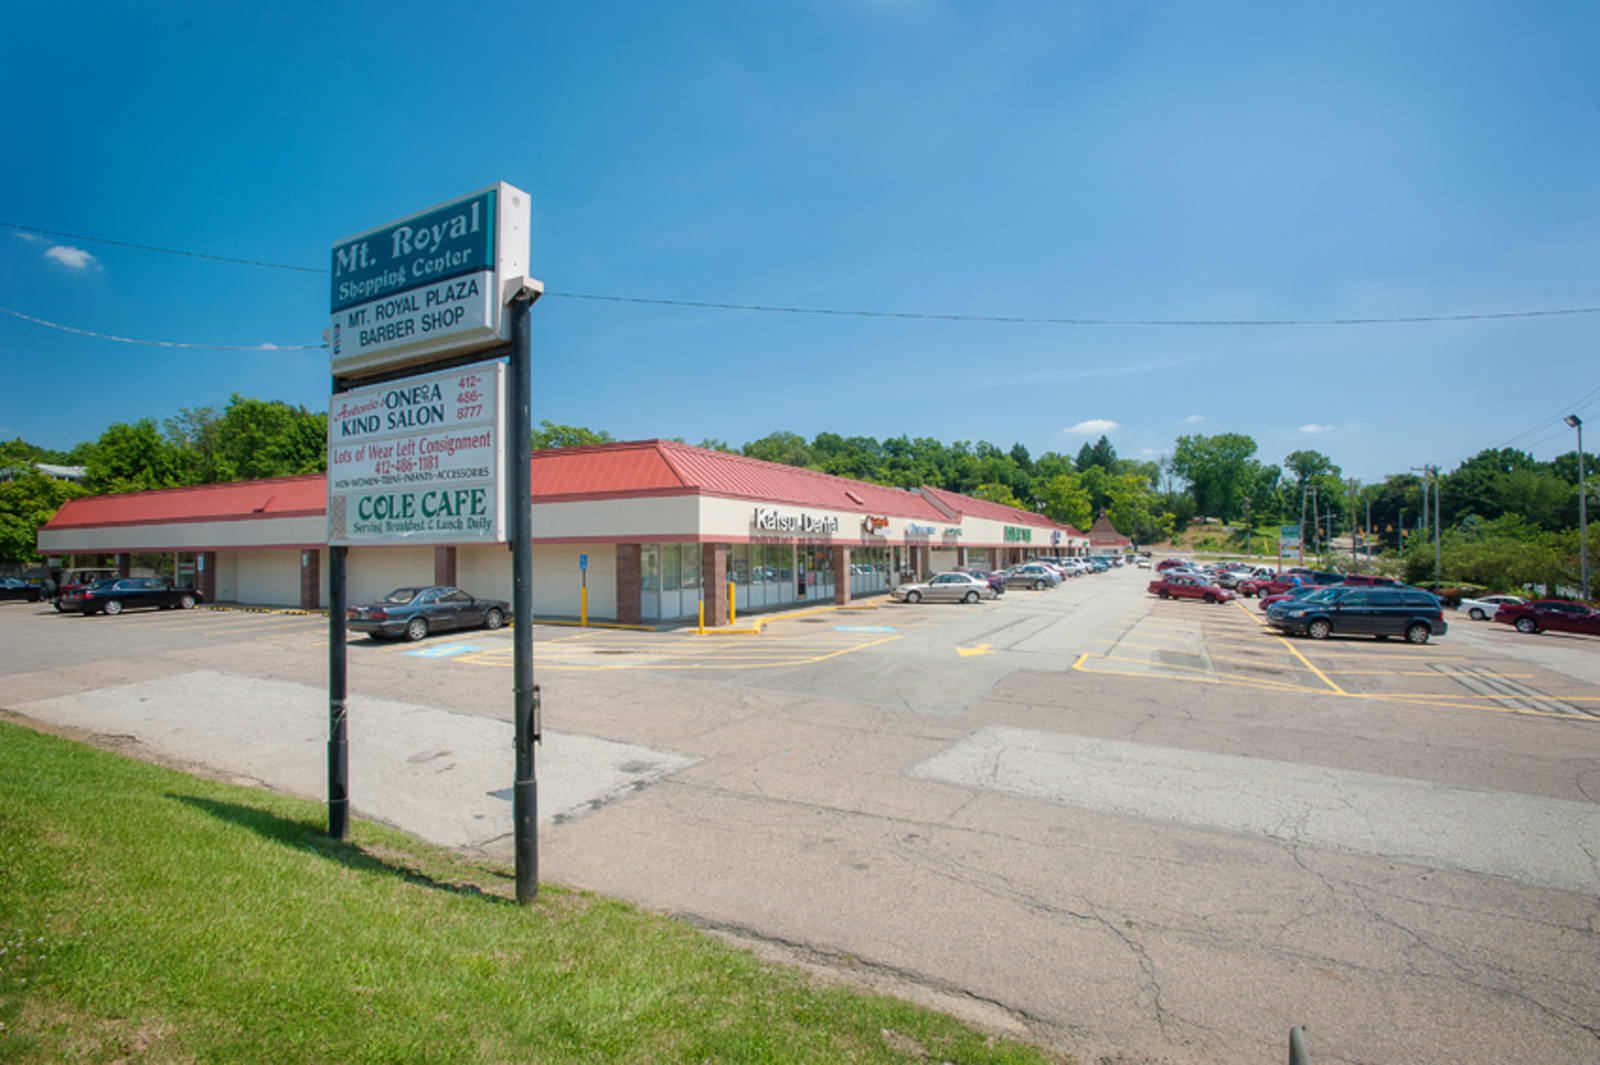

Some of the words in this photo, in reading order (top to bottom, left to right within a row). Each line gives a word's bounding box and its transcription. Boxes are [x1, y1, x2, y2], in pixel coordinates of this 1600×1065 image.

[335, 242, 376, 277] Mt.
[392, 201, 480, 258] Royal
[339, 265, 406, 300] Shopping
[412, 248, 472, 277] Center
[348, 308, 370, 328] MT.
[376, 298, 419, 322] ROYAL
[426, 279, 479, 308] PLAZA
[360, 319, 414, 347] BARBER
[421, 306, 465, 332] SHOP
[342, 416, 380, 436] KIND
[388, 405, 444, 430] SALON
[457, 404, 483, 420] 8777
[333, 448, 353, 465] Lots
[356, 445, 366, 462] of
[368, 444, 394, 461] Wear
[397, 440, 415, 456] Left
[420, 430, 491, 456] Consignment
[358, 494, 416, 521] COLE
[422, 488, 487, 518] CAFE
[466, 516, 493, 532] Daily
